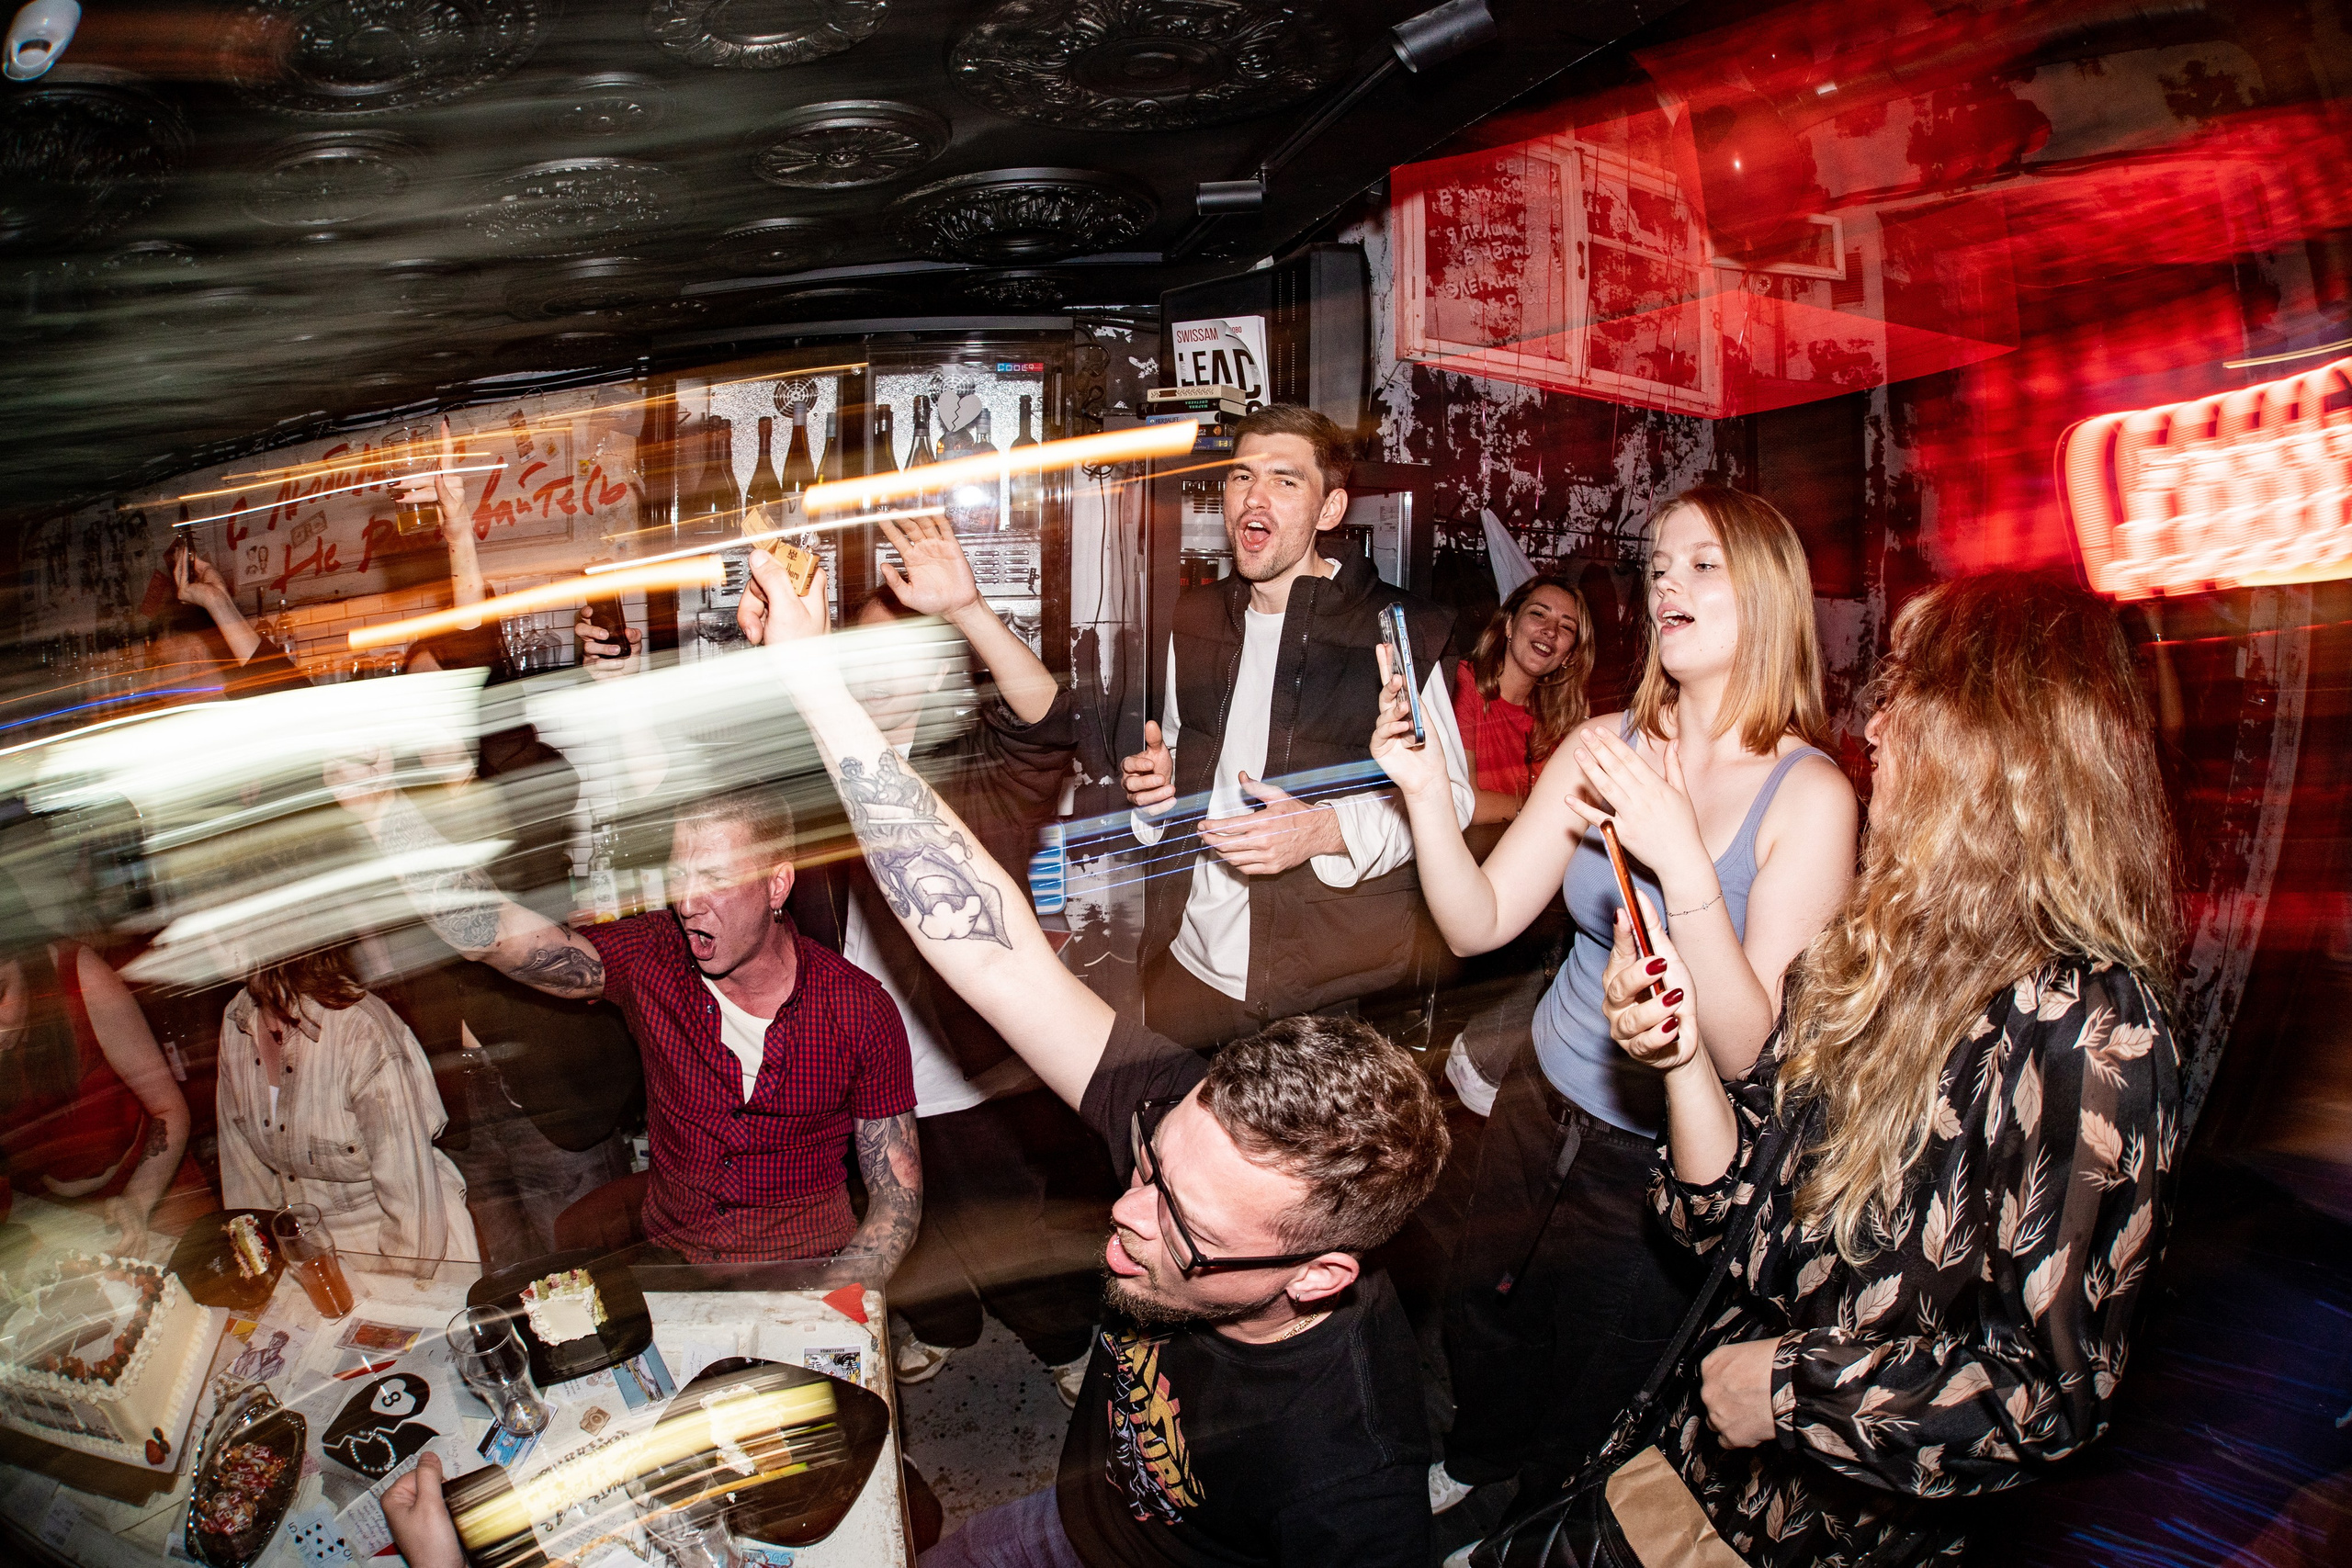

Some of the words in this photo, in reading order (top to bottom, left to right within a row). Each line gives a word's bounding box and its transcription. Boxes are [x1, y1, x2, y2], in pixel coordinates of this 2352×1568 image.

[1439, 187, 1453, 206] В
[1446, 226, 1458, 245] Я
[1463, 248, 1476, 266] В
[1176, 327, 1219, 344] SWISSAM
[288, 1521, 298, 1533] 5
